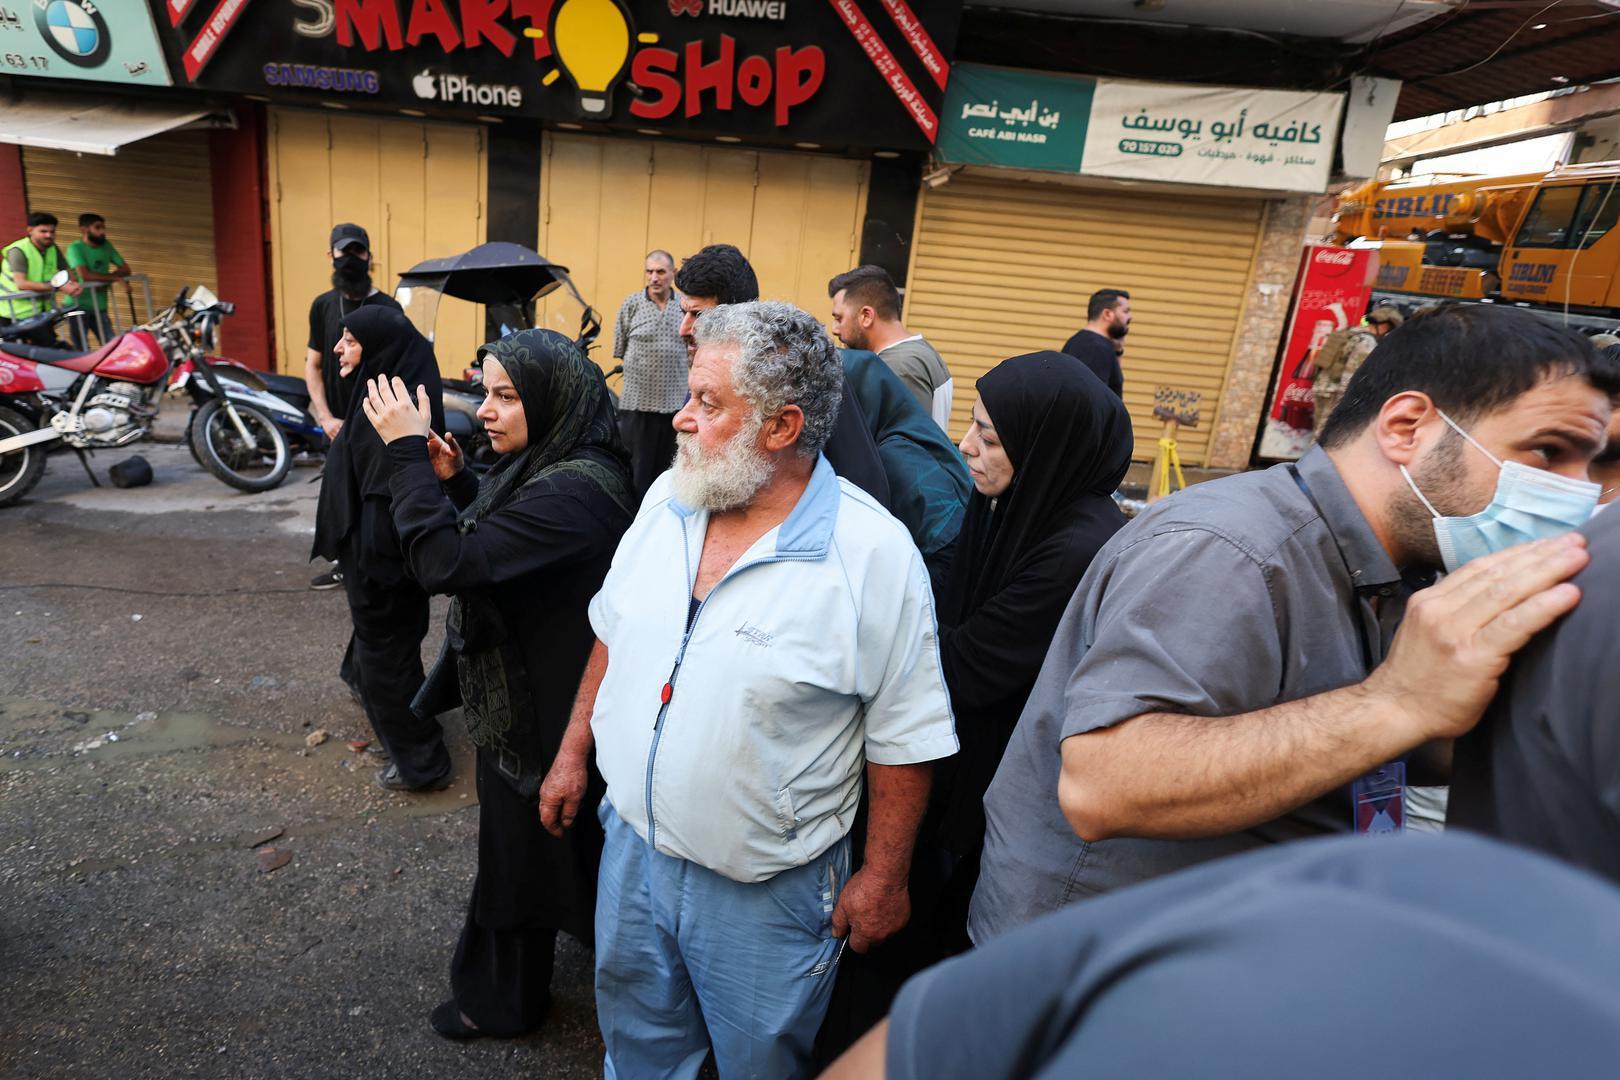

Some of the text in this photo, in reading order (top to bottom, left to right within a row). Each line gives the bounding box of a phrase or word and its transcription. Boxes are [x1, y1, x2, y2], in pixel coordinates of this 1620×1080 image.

[708, 0, 786, 20] HUAWEI
[263, 62, 380, 94] SAMSUNG
[440, 77, 522, 107] iPhone
[629, 34, 826, 127] SHOP
[961, 99, 1060, 129] بن أبي نصر
[1122, 108, 1321, 147] كافيه أبو يوسف
[997, 131, 1016, 141] ABI
[1017, 133, 1047, 144] NASR
